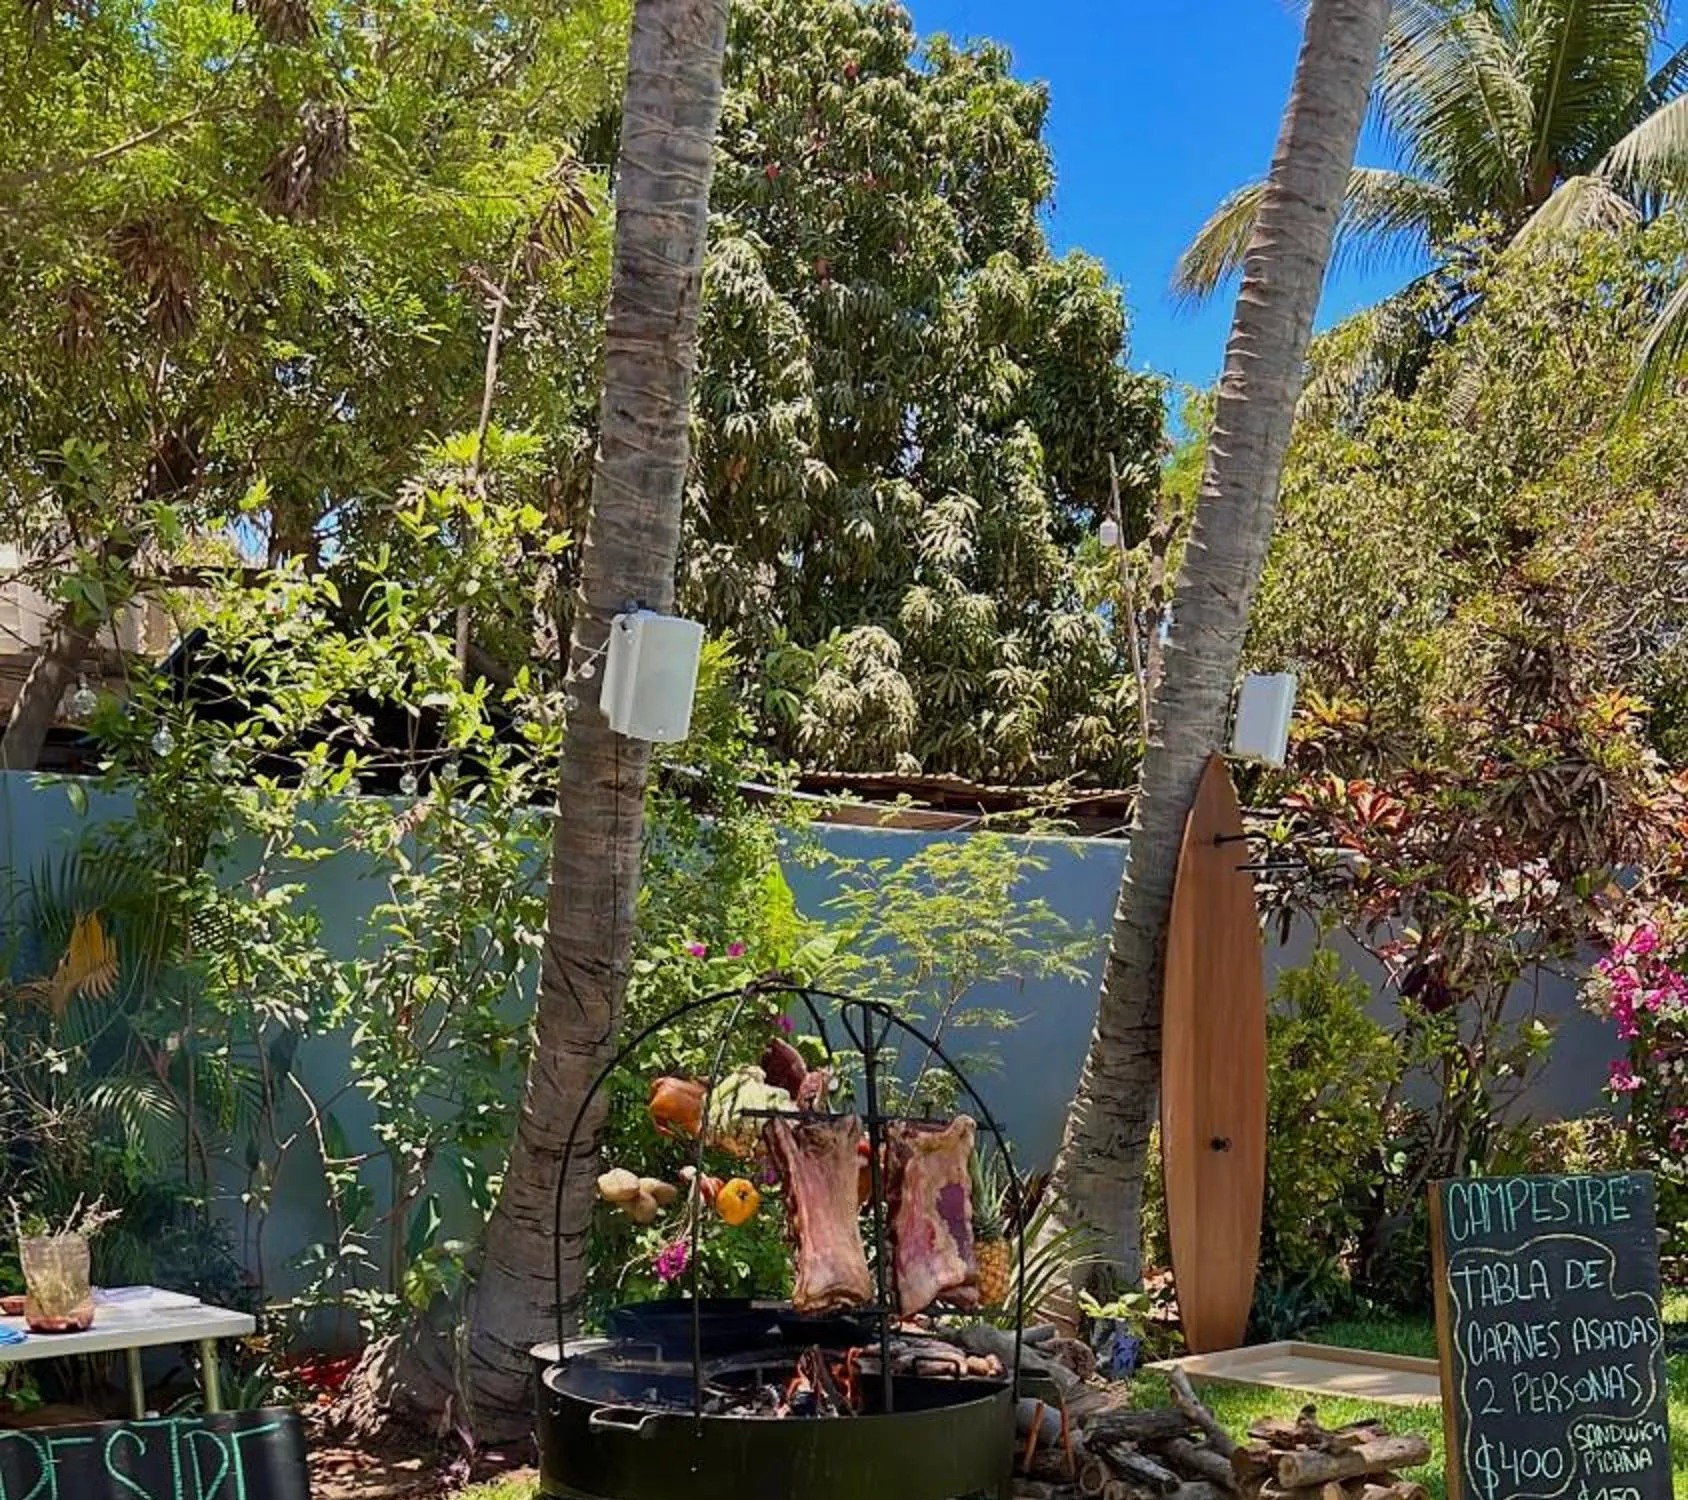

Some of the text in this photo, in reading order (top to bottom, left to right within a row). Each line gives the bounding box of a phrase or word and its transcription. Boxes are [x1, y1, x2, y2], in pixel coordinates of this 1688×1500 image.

[1448, 1175, 1632, 1241] CAMPESTRE
[1451, 1259, 1605, 1311] TABLA DE
[1467, 1315, 1659, 1367] CARNES ASADAS
[1475, 1363, 1643, 1415] 2 PERSONAS
